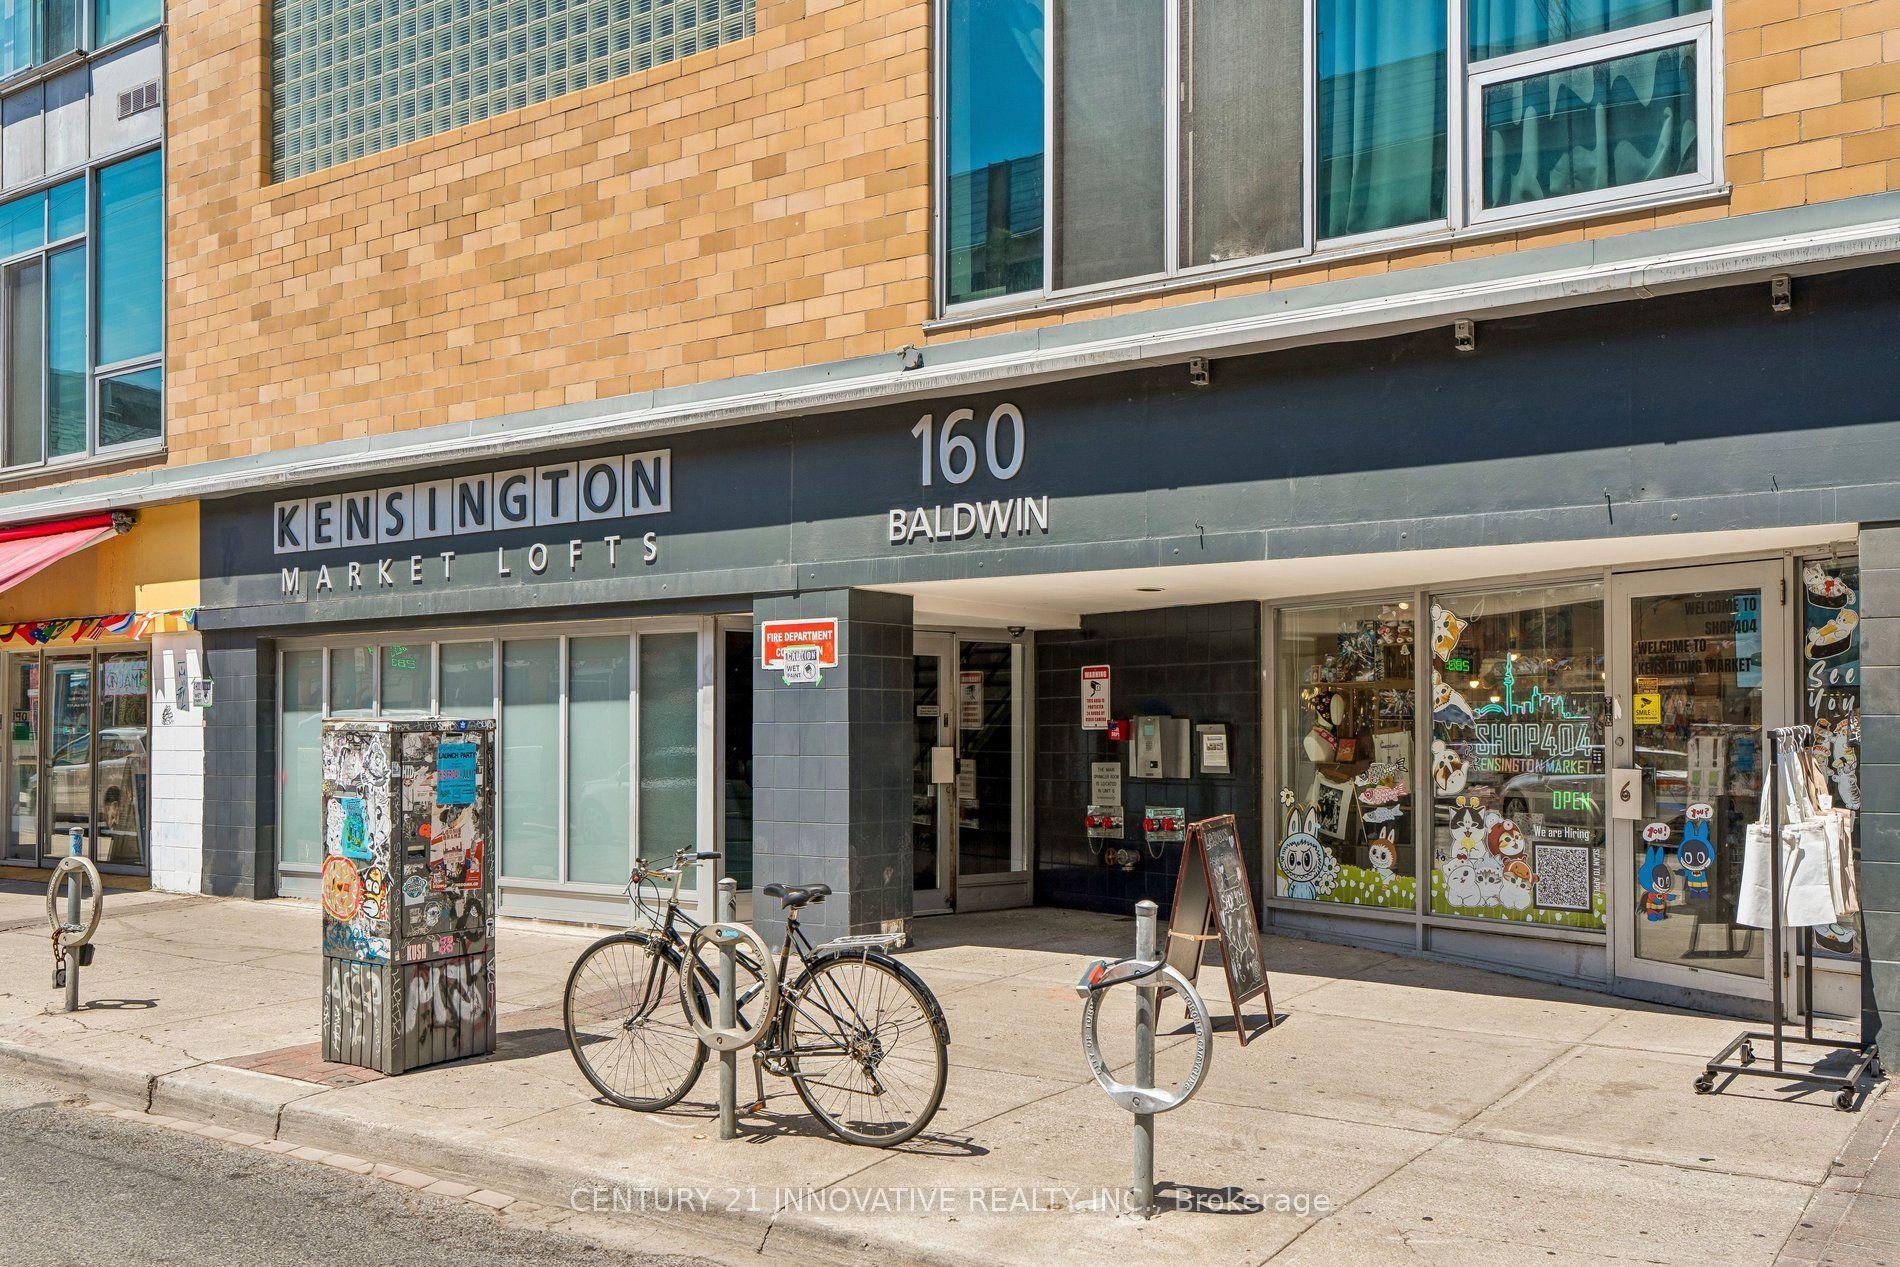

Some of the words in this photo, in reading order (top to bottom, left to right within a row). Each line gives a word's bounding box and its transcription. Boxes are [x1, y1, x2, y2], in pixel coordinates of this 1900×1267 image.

[911, 403, 1025, 485] 160
[277, 457, 662, 548] KENSINGTON
[889, 495, 1049, 546] BALDWIN
[281, 551, 455, 594] MARKET
[498, 532, 658, 578] LOFTS
[1685, 599, 1739, 615] WELCOME
[1743, 597, 1756, 611] TO
[1705, 619, 1757, 635] SHOP404
[767, 632, 783, 643] FIRE
[784, 630, 833, 642] DEPARTMENT
[785, 649, 817, 661] CAUTION
[1638, 640, 1690, 655] WELCOME
[1694, 639, 1706, 653] TO
[1705, 657, 1751, 673] MARKET
[1808, 660, 1856, 688] See
[1475, 723, 1591, 756] SHOP404
[1545, 759, 1592, 774] MARKET
[1620, 780, 1631, 802] 6
[1553, 790, 1591, 811] OPEN
[1533, 824, 1546, 838] We
[1548, 829, 1562, 838] are
[1564, 826, 1590, 842] Hiring
[1593, 868, 1600, 876] TO
[1593, 878, 1601, 898] APPLY
[406, 943, 427, 961] KUSH
